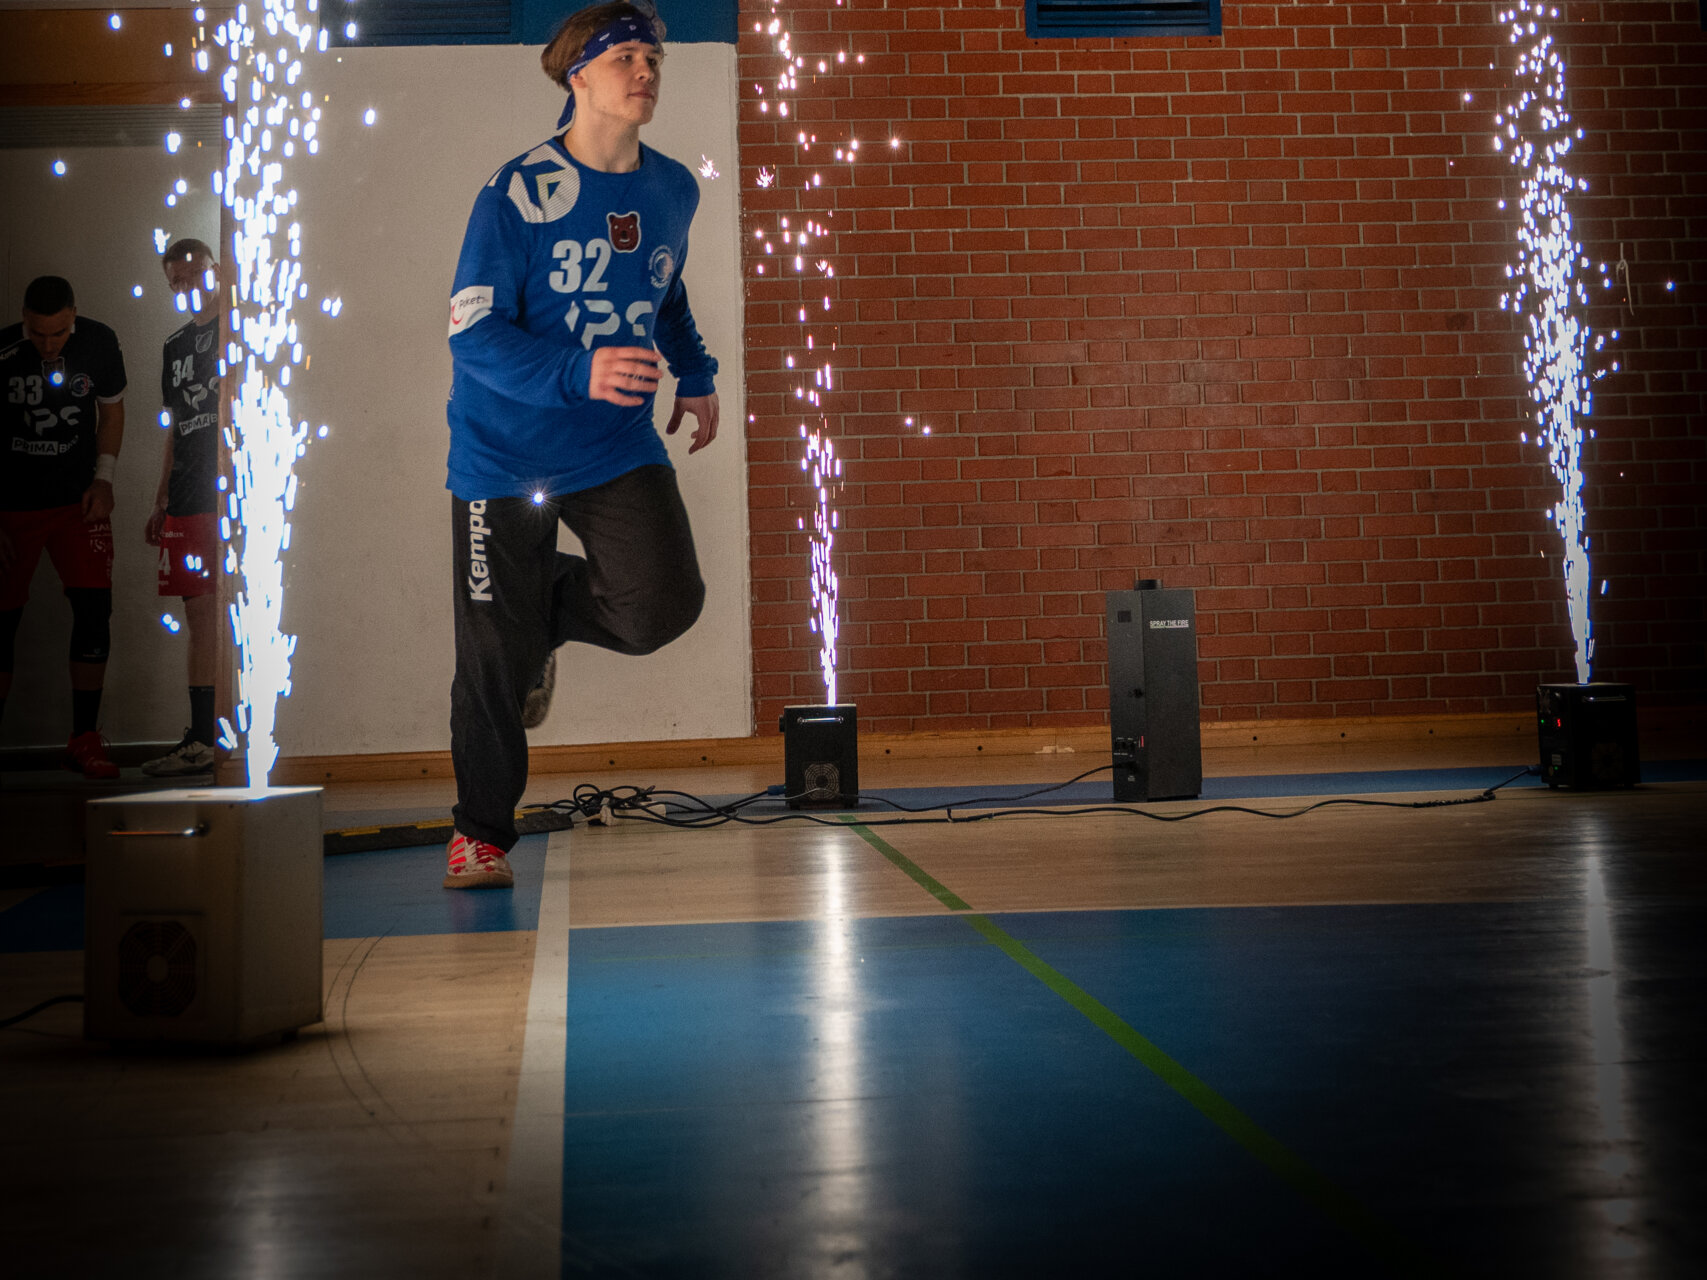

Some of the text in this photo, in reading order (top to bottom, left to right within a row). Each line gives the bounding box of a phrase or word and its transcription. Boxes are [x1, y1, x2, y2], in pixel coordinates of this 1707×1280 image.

[549, 237, 612, 294] 32
[7, 374, 44, 406] 33
[172, 354, 195, 388] 34
[467, 499, 493, 602] Kempa
